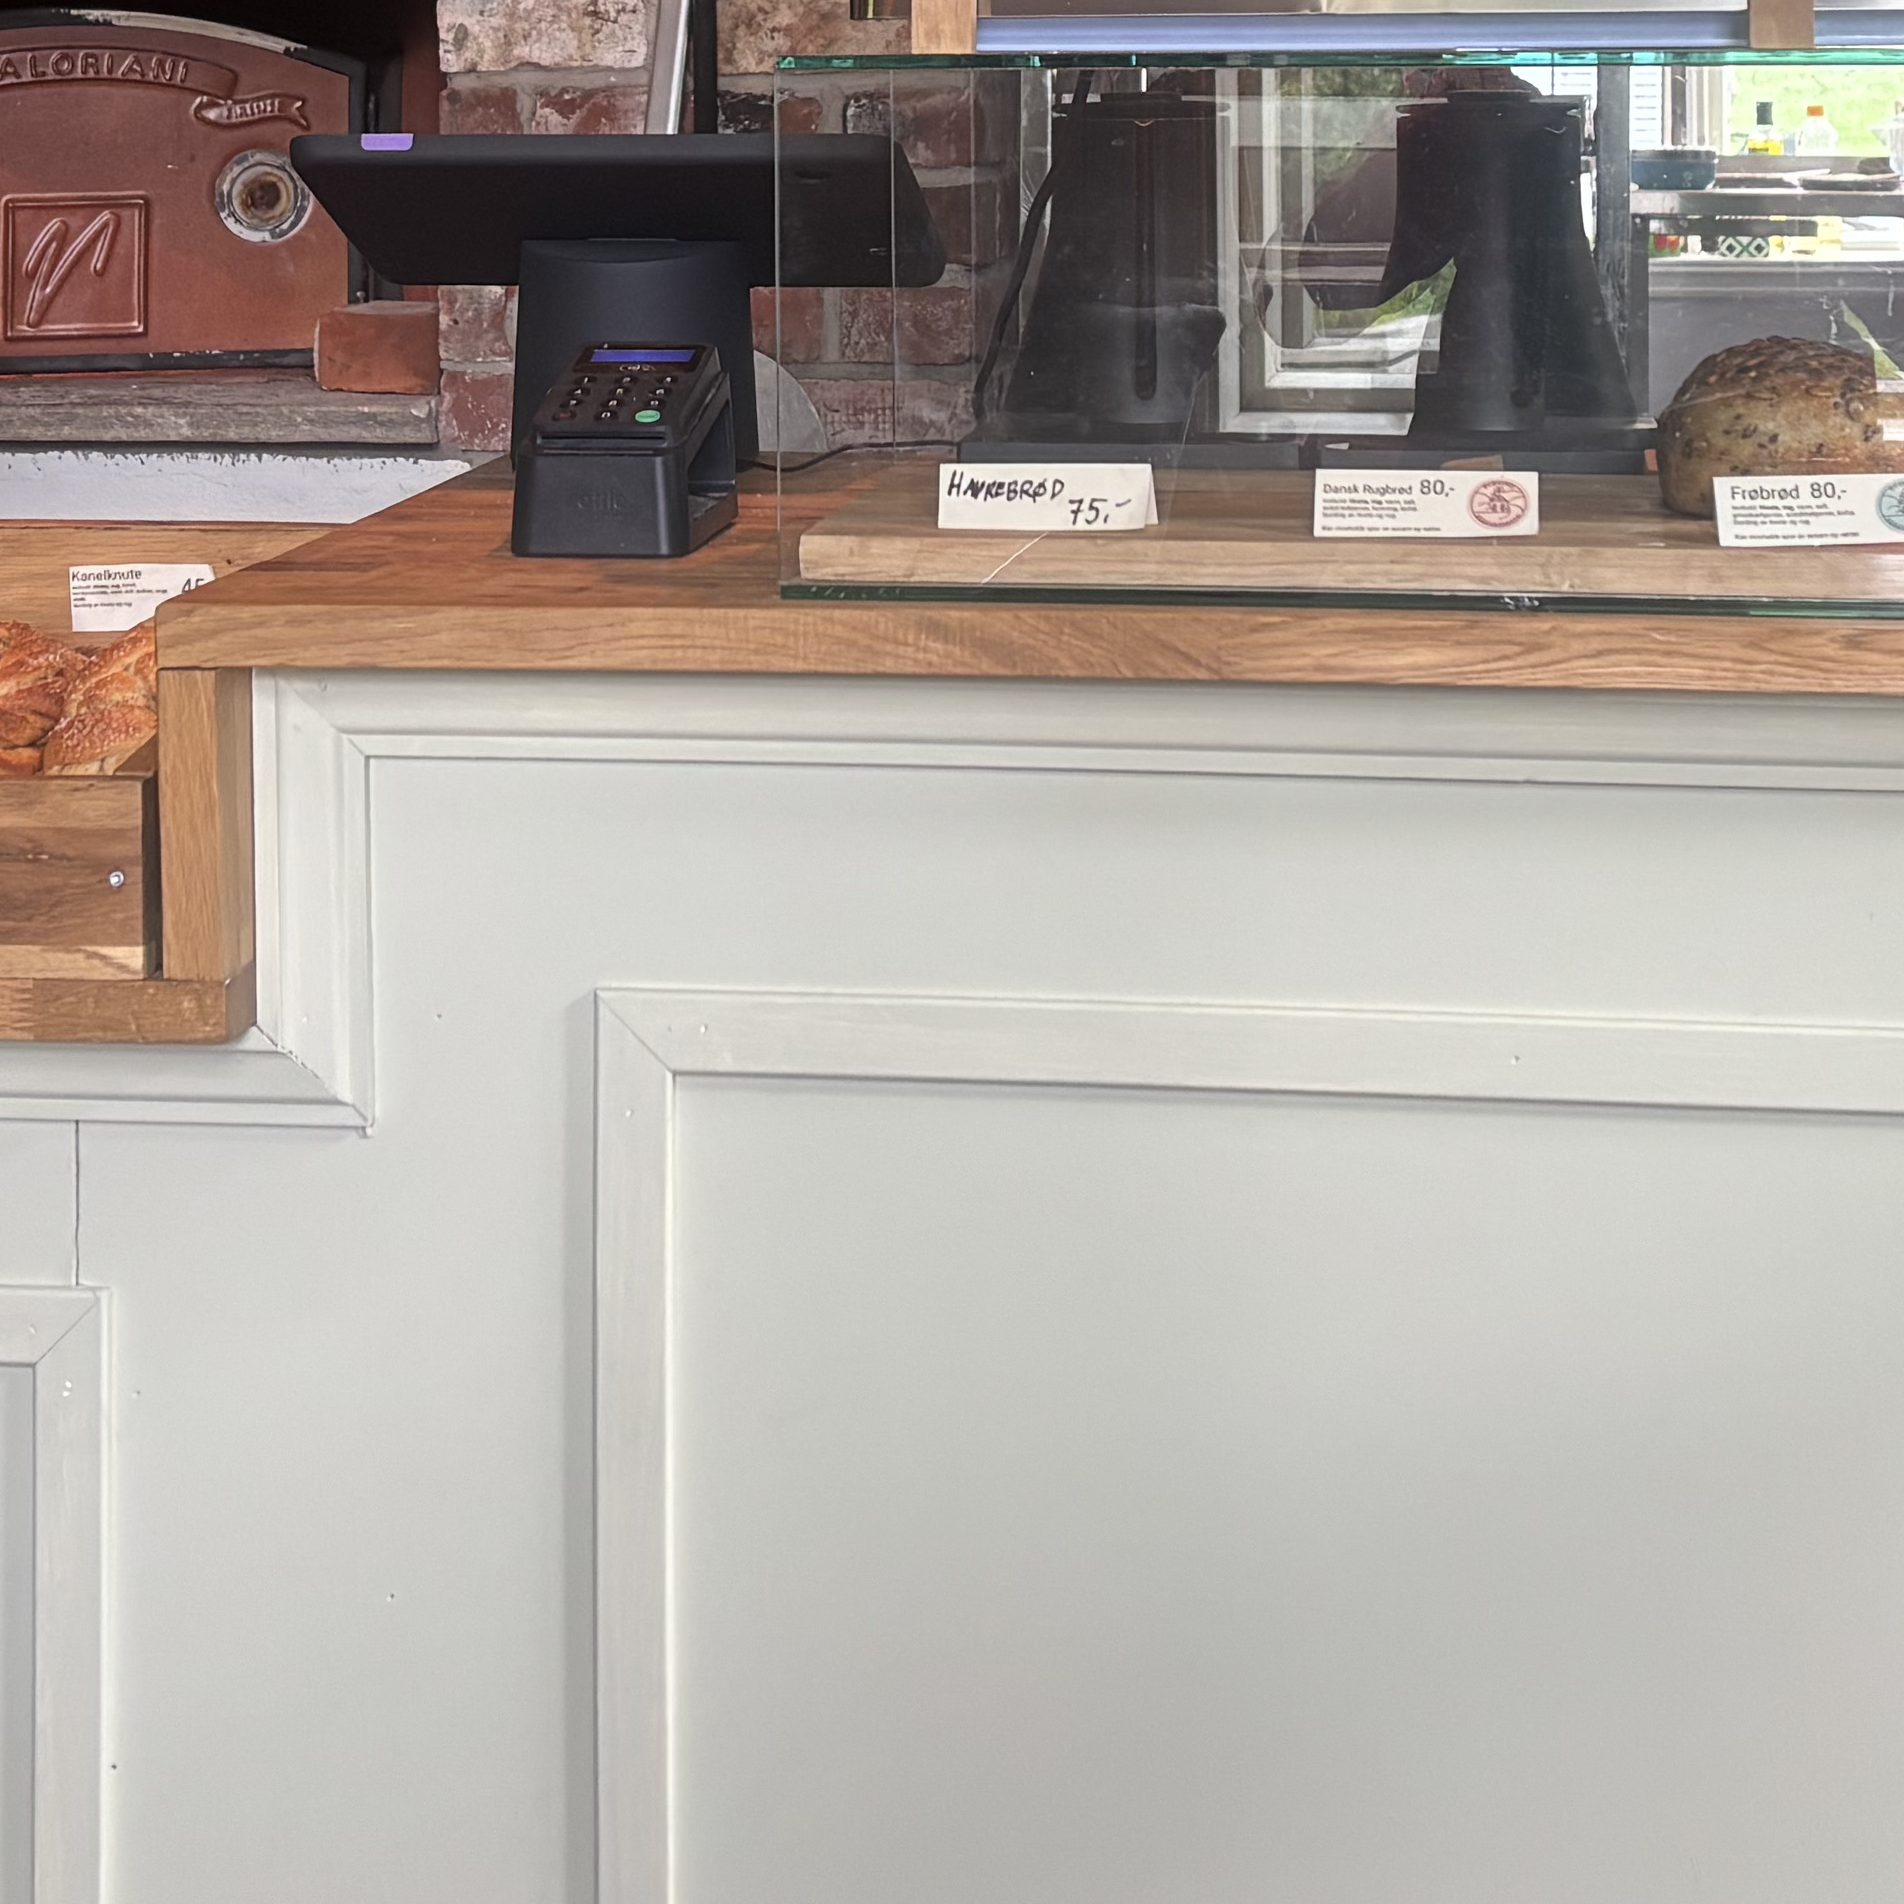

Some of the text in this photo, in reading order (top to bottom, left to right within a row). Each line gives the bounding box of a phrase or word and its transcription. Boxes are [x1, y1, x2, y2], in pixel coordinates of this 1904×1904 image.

[947, 469, 1065, 503] HAVREBRØD
[1323, 478, 1455, 498] Dansk Rugbrød 80,-
[1730, 481, 1847, 501] Frøbrød 80,-
[1068, 498, 1132, 526] 75,-
[71, 568, 142, 583] Kanelknute
